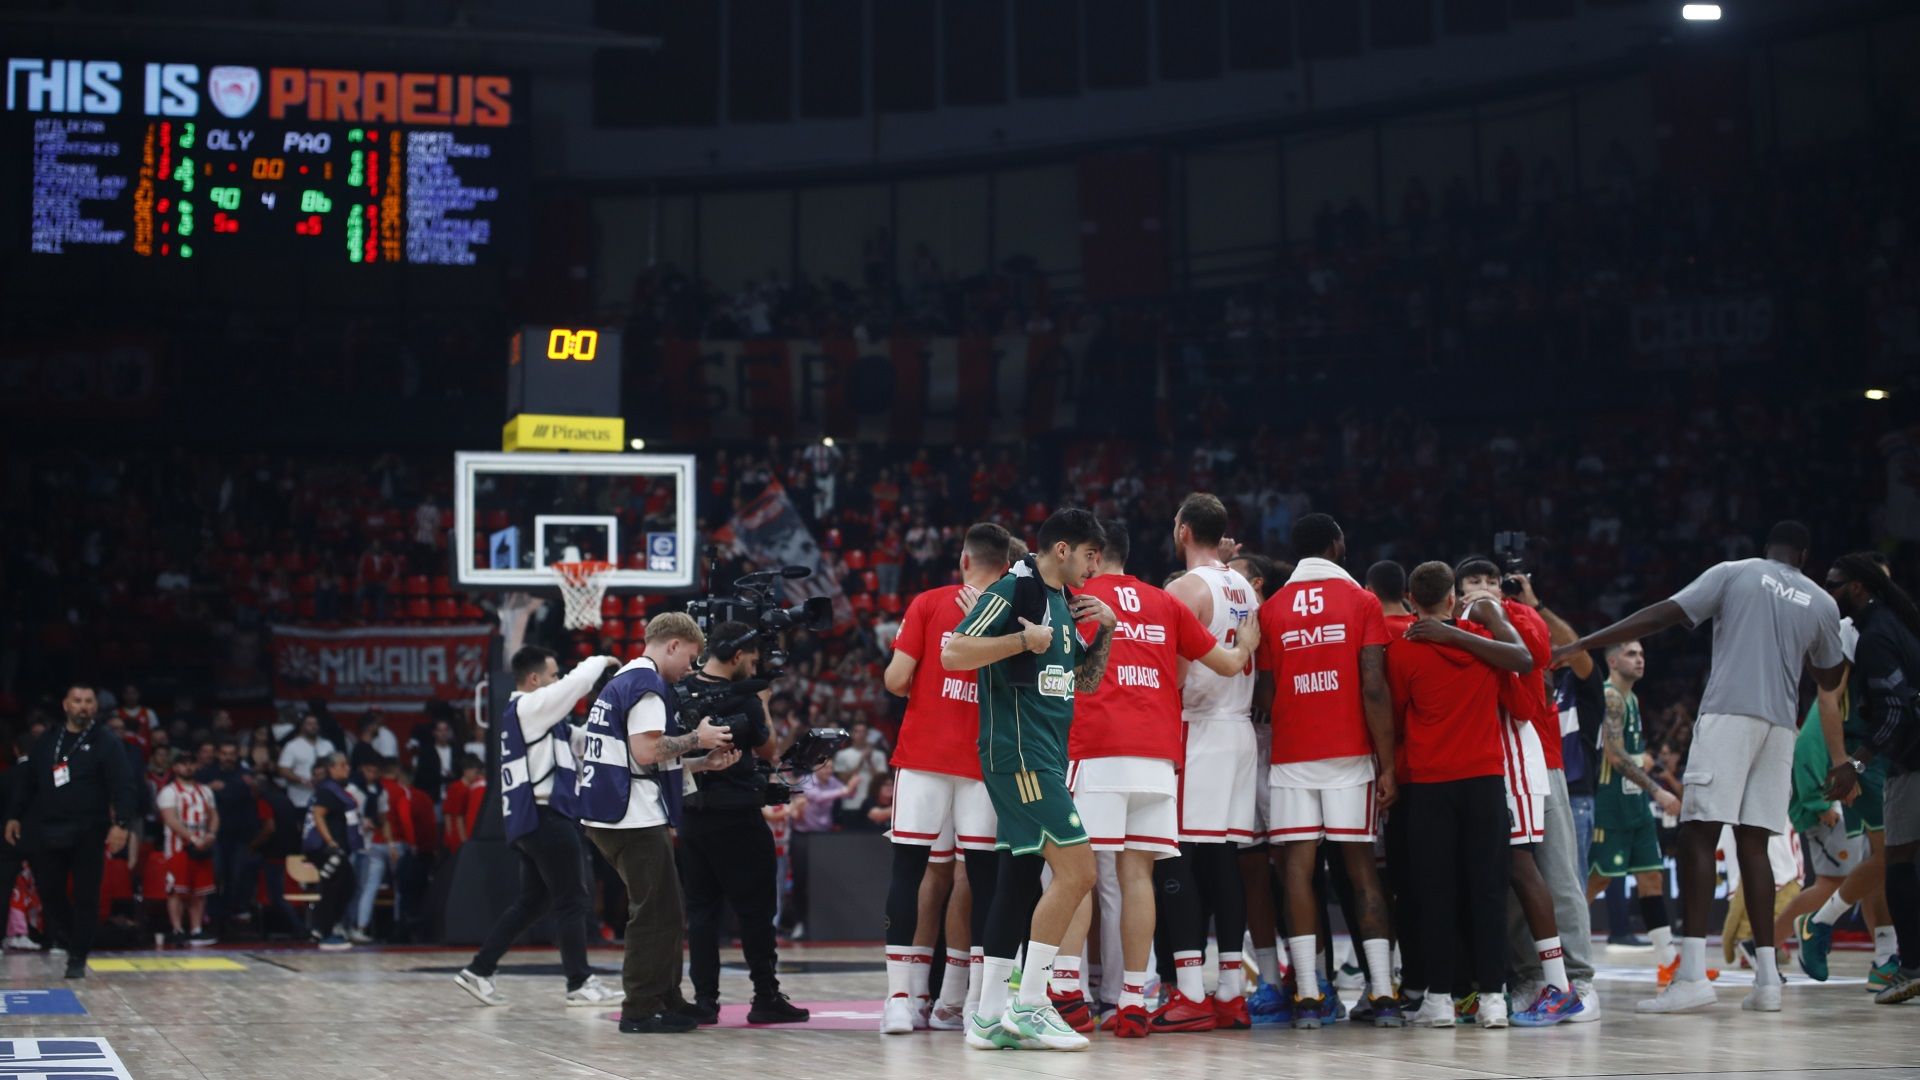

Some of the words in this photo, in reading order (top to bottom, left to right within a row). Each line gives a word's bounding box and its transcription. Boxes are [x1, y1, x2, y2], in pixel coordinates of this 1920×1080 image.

[7, 58, 122, 114] THIS
[144, 62, 200, 117] IS
[206, 128, 255, 151] OLY
[283, 131, 331, 154] PAO
[210, 186, 241, 210] 90
[261, 191, 276, 211] 4
[552, 424, 611, 441] Piraeus
[1113, 586, 1141, 612] 16
[1292, 587, 1325, 617] 45
[1761, 574, 1812, 609] FMS
[1062, 624, 1072, 654] 5
[1280, 623, 1346, 648] FMS
[1117, 665, 1160, 689] PIRAEUS
[1293, 670, 1339, 695] PIRAEUS
